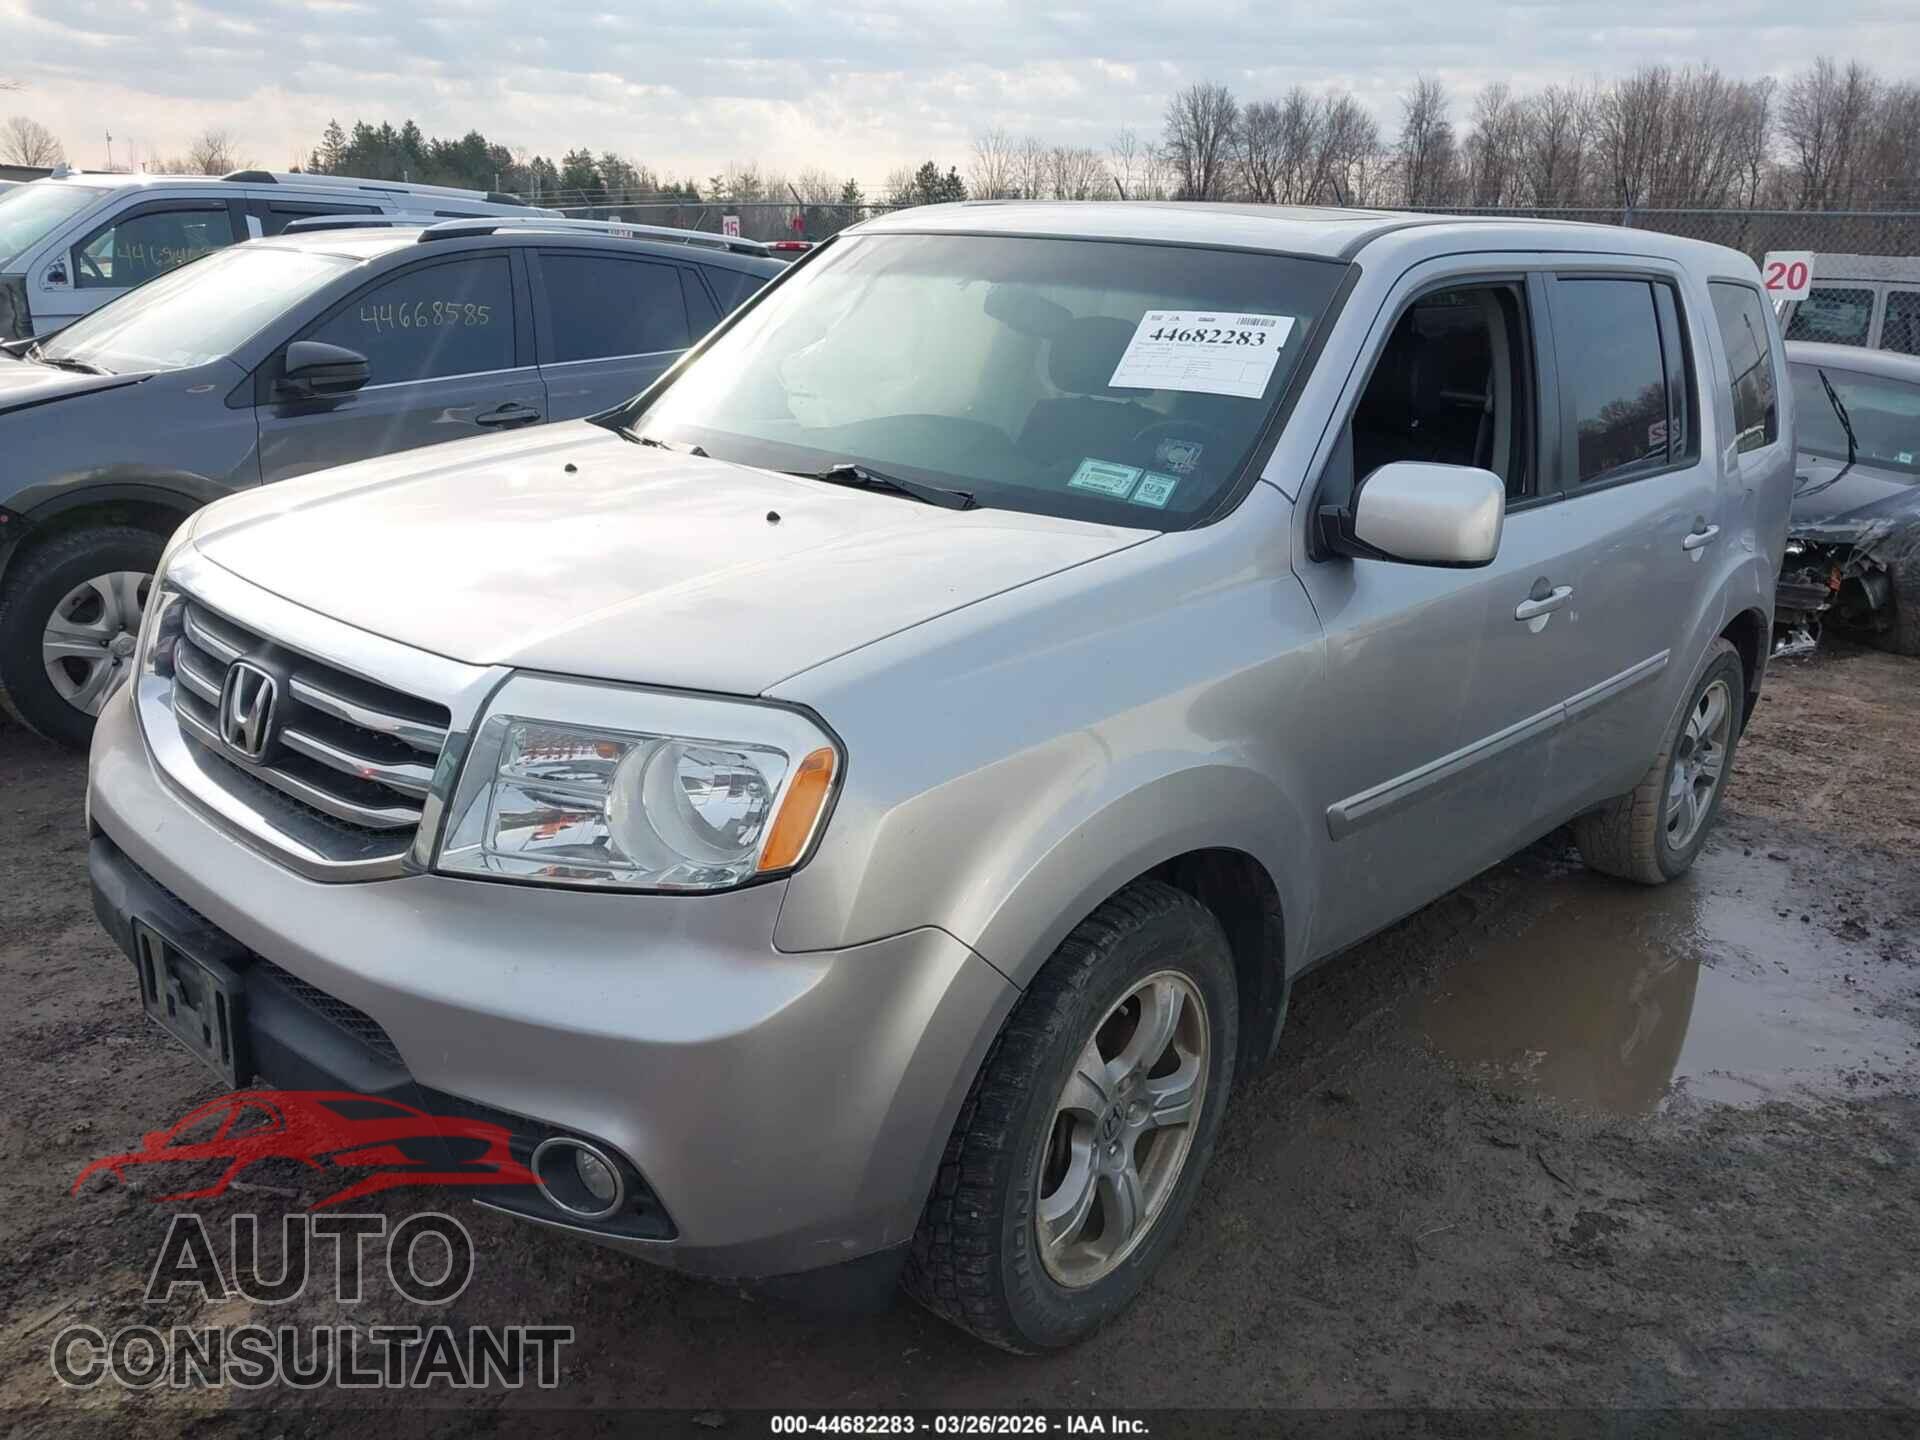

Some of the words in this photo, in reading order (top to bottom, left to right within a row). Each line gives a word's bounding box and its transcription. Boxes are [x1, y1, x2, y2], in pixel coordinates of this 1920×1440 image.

[1765, 262, 1808, 290] 20
[360, 301, 491, 333] 44668585
[1149, 327, 1267, 347] 44682283
